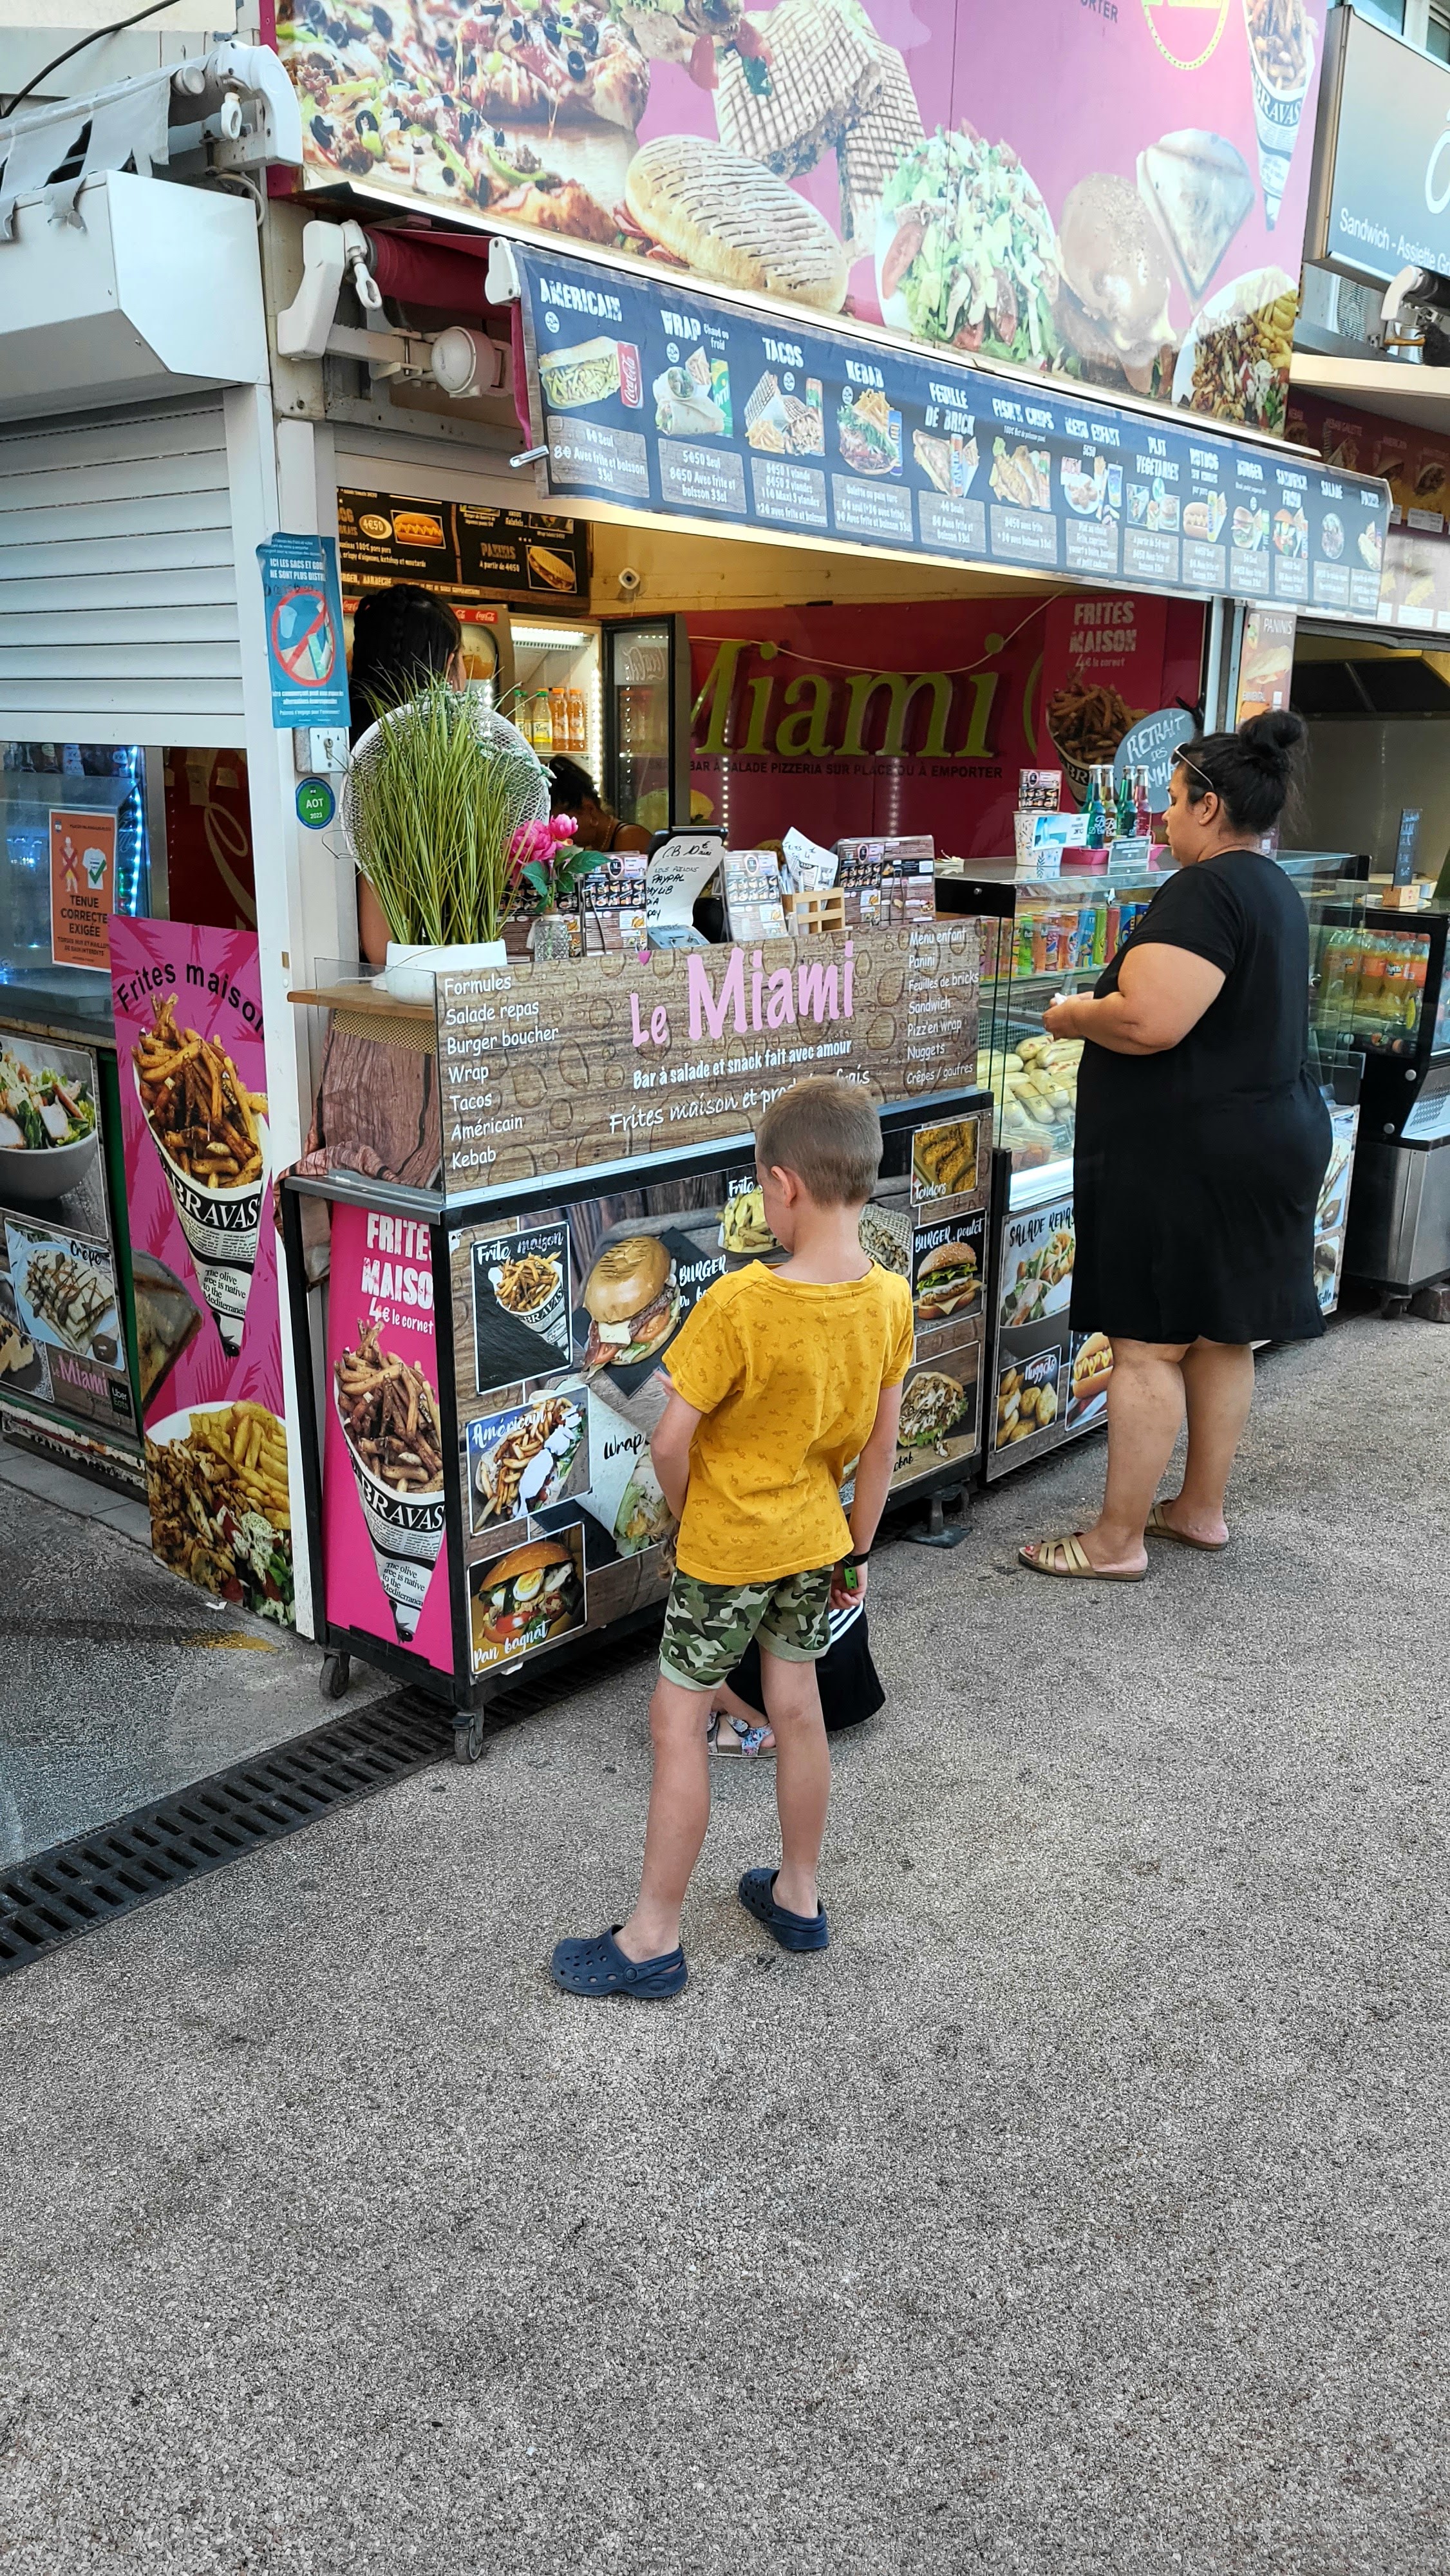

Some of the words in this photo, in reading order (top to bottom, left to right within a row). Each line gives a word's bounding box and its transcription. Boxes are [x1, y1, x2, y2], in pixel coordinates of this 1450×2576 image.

[1340, 208, 1389, 251] Sandwich
[1397, 235, 1435, 270] Assiette
[540, 278, 622, 321] AMERICAIN
[660, 310, 701, 341] WRAP
[711, 336, 725, 350] froid
[762, 337, 804, 368] TACOS
[845, 359, 884, 388] KEBAB
[929, 383, 968, 409] FEUILLE
[925, 405, 939, 428] DE
[944, 410, 975, 436] BRICK
[554, 446, 571, 459] 8€
[574, 445, 592, 462] Avec
[694, 473, 711, 486] Avec
[682, 484, 710, 500] boisson
[362, 519, 384, 531] 4€50
[270, 558, 279, 567] ICI
[279, 559, 289, 567] LES
[290, 560, 304, 569] SACS
[279, 570, 293, 579] SONT
[294, 571, 307, 580] PLUS
[1074, 601, 1135, 626] FRITES
[1069, 629, 1137, 653] MAISON
[771, 762, 822, 773] PIZZERIA
[825, 763, 849, 775] SUR
[931, 766, 1003, 779] EMPORTER
[306, 799, 323, 808] AOT
[652, 873, 684, 885] PAYPAL
[70, 895, 99, 908] TENUE
[61, 908, 108, 923] CORRECTE
[70, 922, 100, 937] EXIGÉE
[910, 931, 934, 946] Menu
[937, 927, 966, 943] enfant
[909, 953, 936, 969] Panini
[117, 963, 176, 1013] Frites
[445, 973, 511, 996] Formules
[909, 977, 938, 992] Feuilles
[940, 976, 949, 987] de
[952, 970, 979, 986] bricks
[630, 992, 667, 1048] Le
[687, 940, 854, 1041] Miami
[909, 996, 951, 1014] Sandwich
[446, 1003, 495, 1026] Salade
[500, 1001, 539, 1022] repas
[907, 1021, 938, 1037] Pizz'en
[940, 1019, 962, 1034] wrap
[447, 1036, 497, 1057] Burger
[502, 1026, 558, 1048] boucher
[907, 1044, 945, 1061] Nuggets
[448, 1065, 489, 1084] Wrap
[633, 1070, 657, 1090] Bar
[659, 1066, 668, 1085] à
[670, 1063, 710, 1084] salade
[713, 1060, 724, 1075] et
[728, 1051, 762, 1073] snack
[765, 1048, 786, 1067] fait
[788, 1047, 814, 1064] avec
[816, 1040, 852, 1059] amour
[907, 1068, 934, 1085] Crêpes
[937, 1066, 941, 1078] /
[943, 1063, 973, 1081] gaufres
[449, 1093, 492, 1112] Tacos
[609, 1105, 664, 1133] Frites
[670, 1092, 739, 1122] maison
[742, 1090, 758, 1108] et
[451, 1115, 523, 1141] Américain
[452, 1146, 496, 1170] Kebab
[729, 1176, 755, 1197] Frite
[913, 1184, 946, 1200] Tenders
[173, 1175, 258, 1229] BRAVAS
[367, 1212, 431, 1262] FRITE
[915, 1226, 952, 1253] BURGER
[957, 1218, 985, 1241] poulet
[1010, 1218, 1045, 1247] SALADE
[70, 1240, 102, 1265] Crêpe
[477, 1240, 511, 1265] Frite
[517, 1232, 564, 1254] maison
[205, 1269, 218, 1278] The
[220, 1271, 238, 1284] olive
[679, 1255, 728, 1287] BURGER
[203, 1283, 211, 1291] to
[212, 1287, 222, 1298] the
[218, 1280, 224, 1289] is
[225, 1284, 246, 1298] native
[361, 1257, 435, 1311] MAISO
[369, 1296, 390, 1323] 4€
[392, 1309, 400, 1325] le
[402, 1314, 434, 1335] cornet
[524, 1288, 562, 1324] BRAVAS
[59, 1355, 109, 1397] Miami
[1025, 1355, 1057, 1384] Nuggets
[112, 1387, 127, 1400] Uber
[472, 1409, 547, 1449] Américain
[604, 1432, 644, 1460] Wrap
[894, 1452, 913, 1472] ebab
[362, 1477, 445, 1530] BRAVAS
[382, 1573, 390, 1582] to
[391, 1578, 401, 1589] the
[398, 1572, 403, 1580] is
[404, 1577, 425, 1591] native
[400, 1564, 417, 1578] olive
[474, 1647, 499, 1669] Pan
[505, 1619, 552, 1654] bagnat
